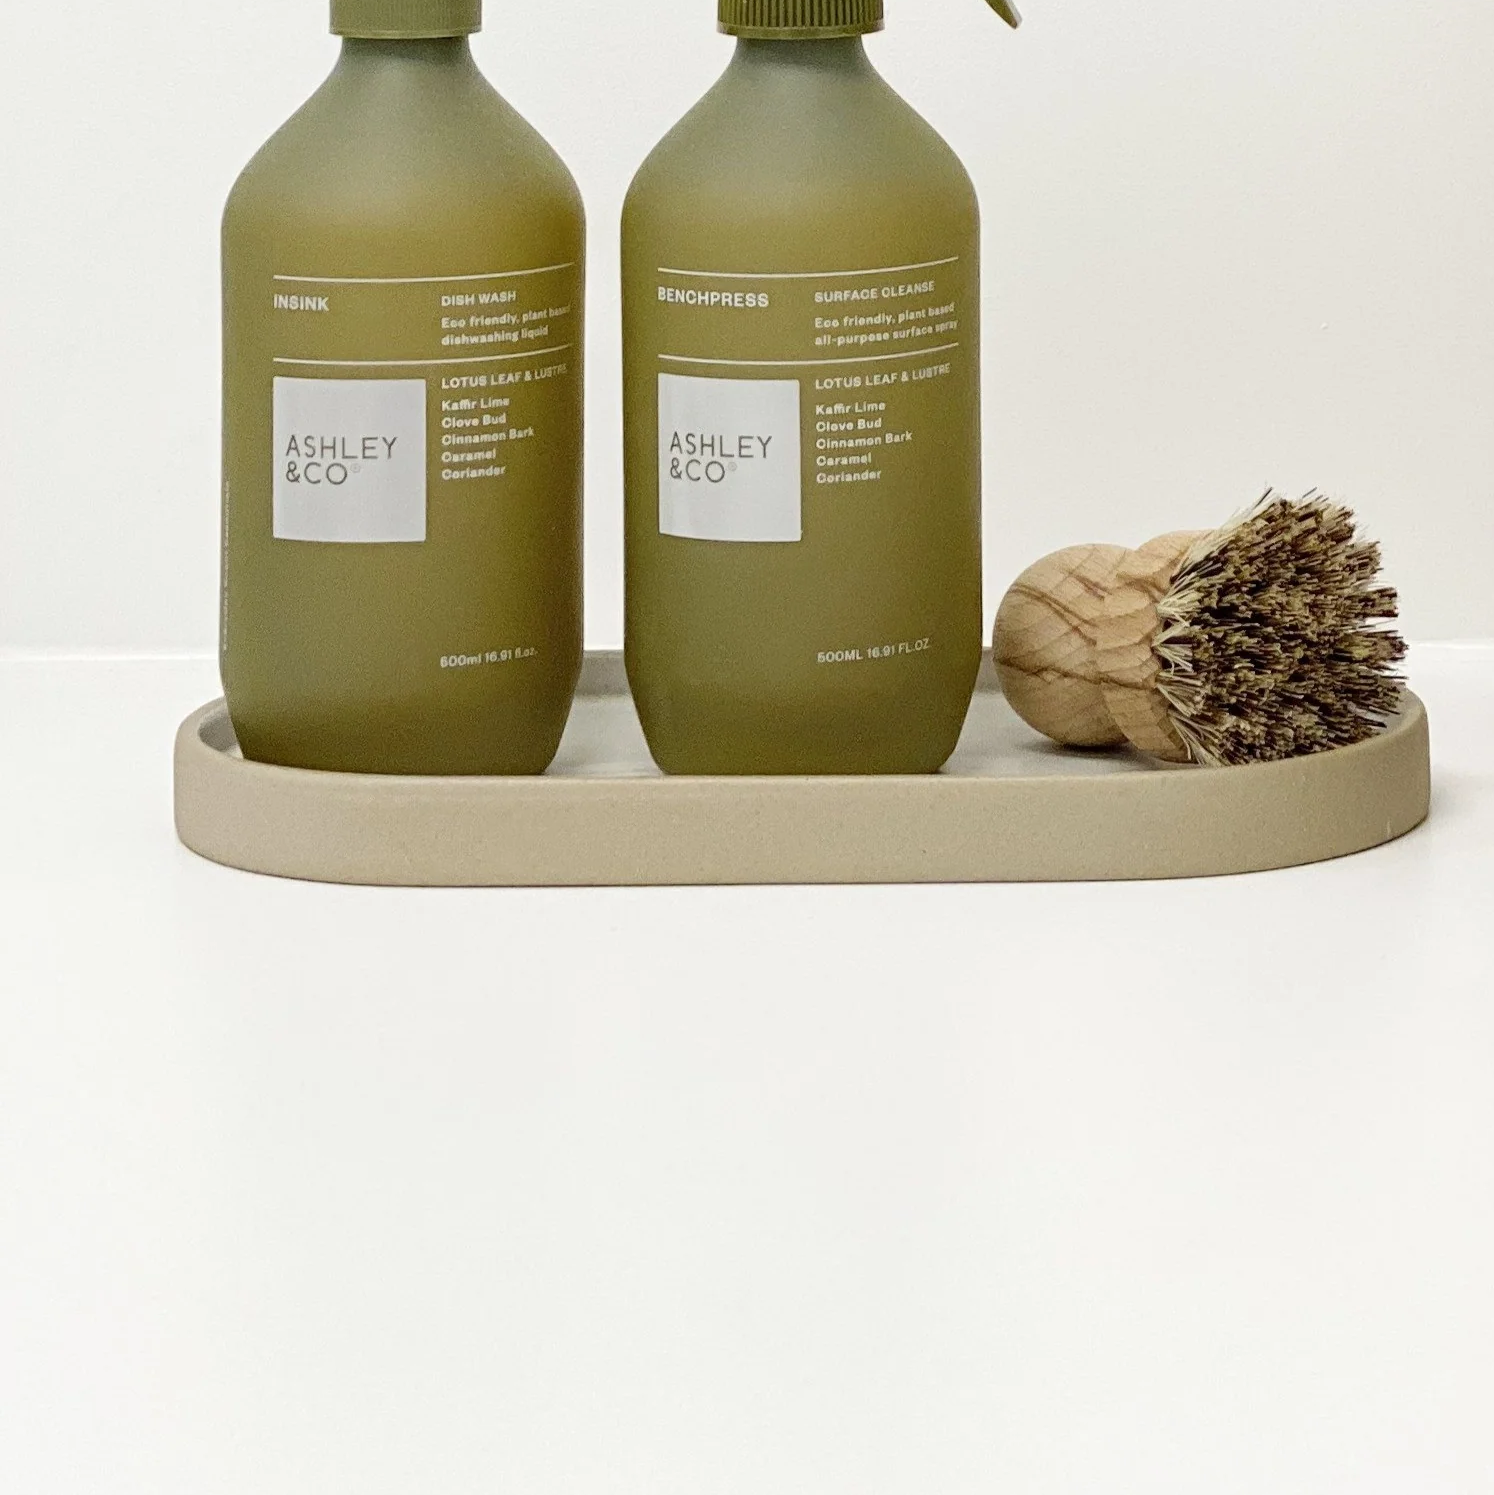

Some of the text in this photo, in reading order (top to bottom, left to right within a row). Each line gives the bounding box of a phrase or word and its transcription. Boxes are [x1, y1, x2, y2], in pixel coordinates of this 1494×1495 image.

[441, 291, 517, 306] DISH WASH
[657, 286, 769, 307] BENCHPRESS
[814, 280, 935, 302] SURFACE CLEANSE
[273, 294, 329, 311] INSINK
[441, 317, 466, 328] Eco
[522, 307, 548, 323] plant
[815, 318, 839, 328] Eco
[898, 309, 926, 323] plant
[928, 302, 955, 317] based
[441, 325, 549, 345] dishwashing liquid
[815, 319, 958, 346] all-purpose surface spray
[441, 376, 487, 389] LOTUS
[490, 372, 521, 385] LEAF
[524, 370, 532, 381] &
[815, 362, 951, 389] LOTUS LEAF & LUSTRE
[480, 397, 510, 408] Lime
[855, 401, 886, 413] Lime
[441, 412, 507, 428] Clove Bud
[815, 417, 882, 432] Clove Bud
[441, 427, 534, 445] Cinnamon Bark
[670, 431, 772, 458] ASHLEY
[815, 430, 913, 449] Cinnamon Bark
[285, 434, 398, 459] ASHLEY
[441, 449, 497, 462] Caramel
[815, 452, 872, 466] Caramel
[441, 466, 506, 480] Coriander
[816, 469, 882, 483] Coriander
[485, 649, 512, 663] 16.91
[867, 645, 896, 660] 16.91
